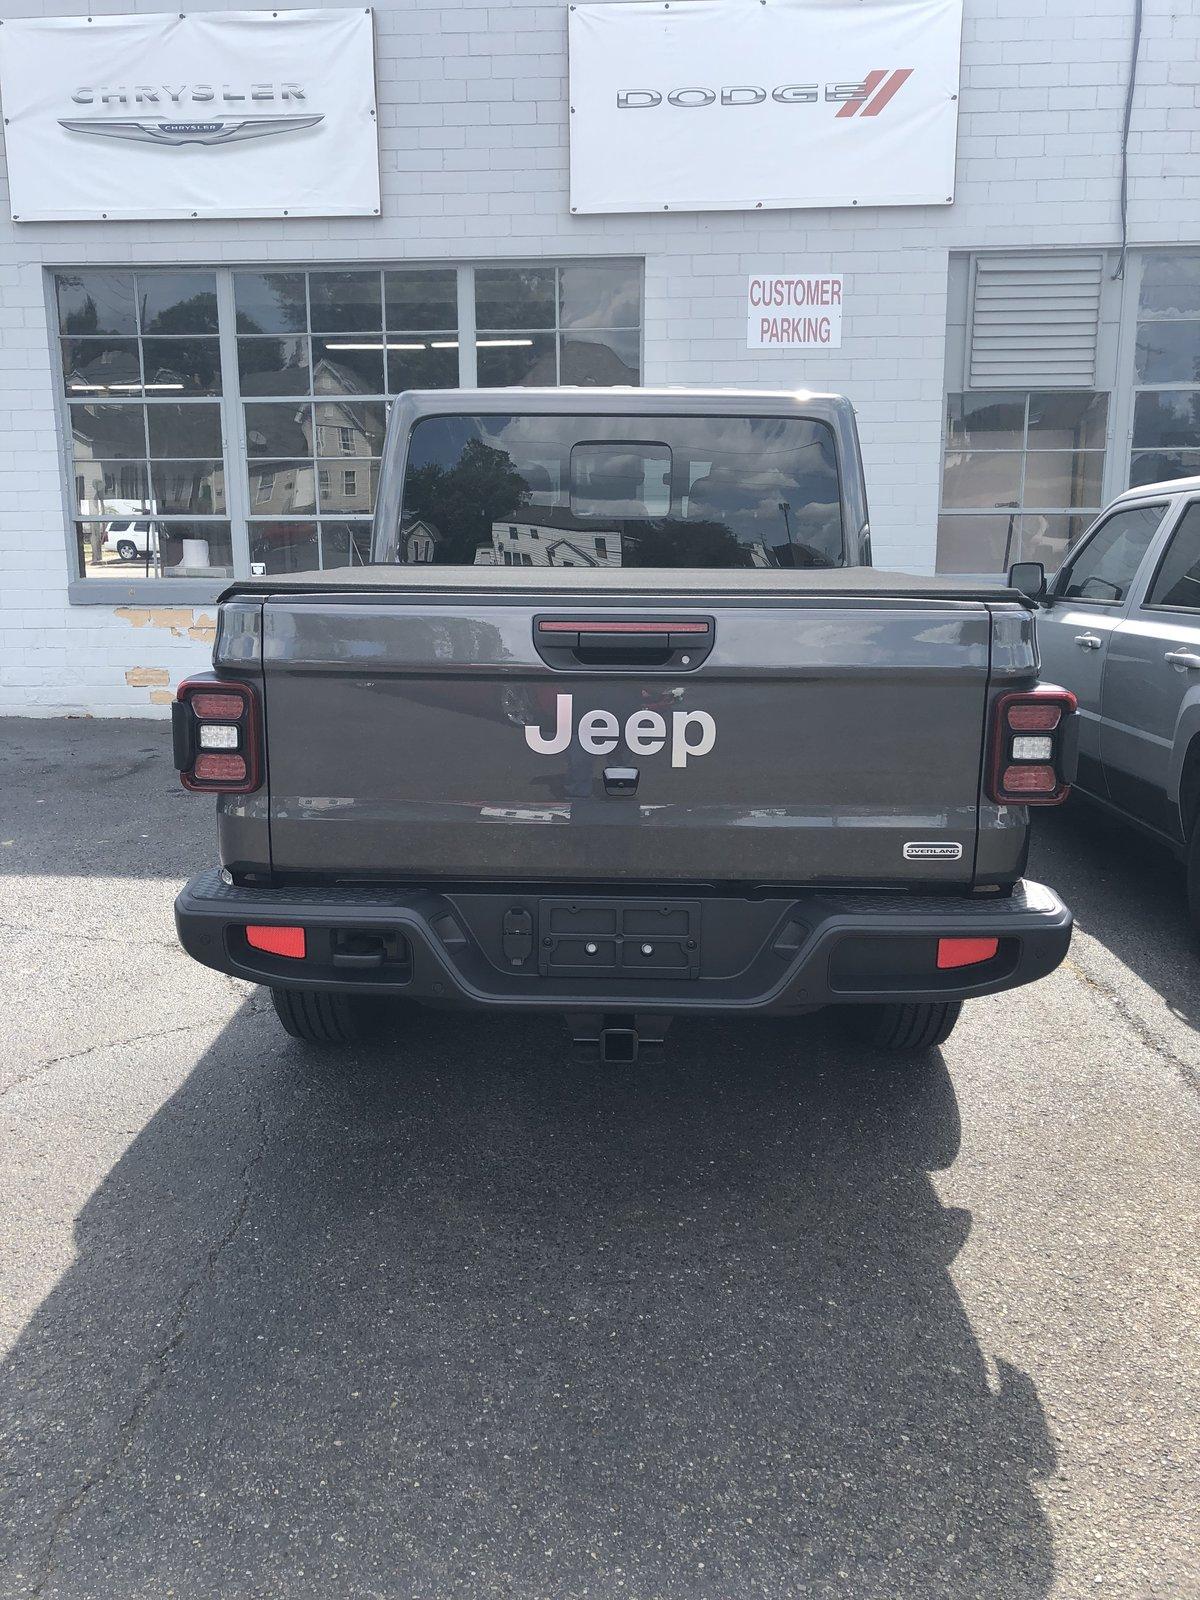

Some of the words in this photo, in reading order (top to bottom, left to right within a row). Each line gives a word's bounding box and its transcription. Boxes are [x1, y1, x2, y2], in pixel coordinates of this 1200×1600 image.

[70, 82, 306, 104] CHRYSLER
[616, 82, 868, 108] DODGE
[164, 124, 217, 132] CHRYSLER
[750, 279, 841, 306] CUSTOMER
[760, 317, 831, 343] PARKING
[524, 694, 717, 768] Jeep
